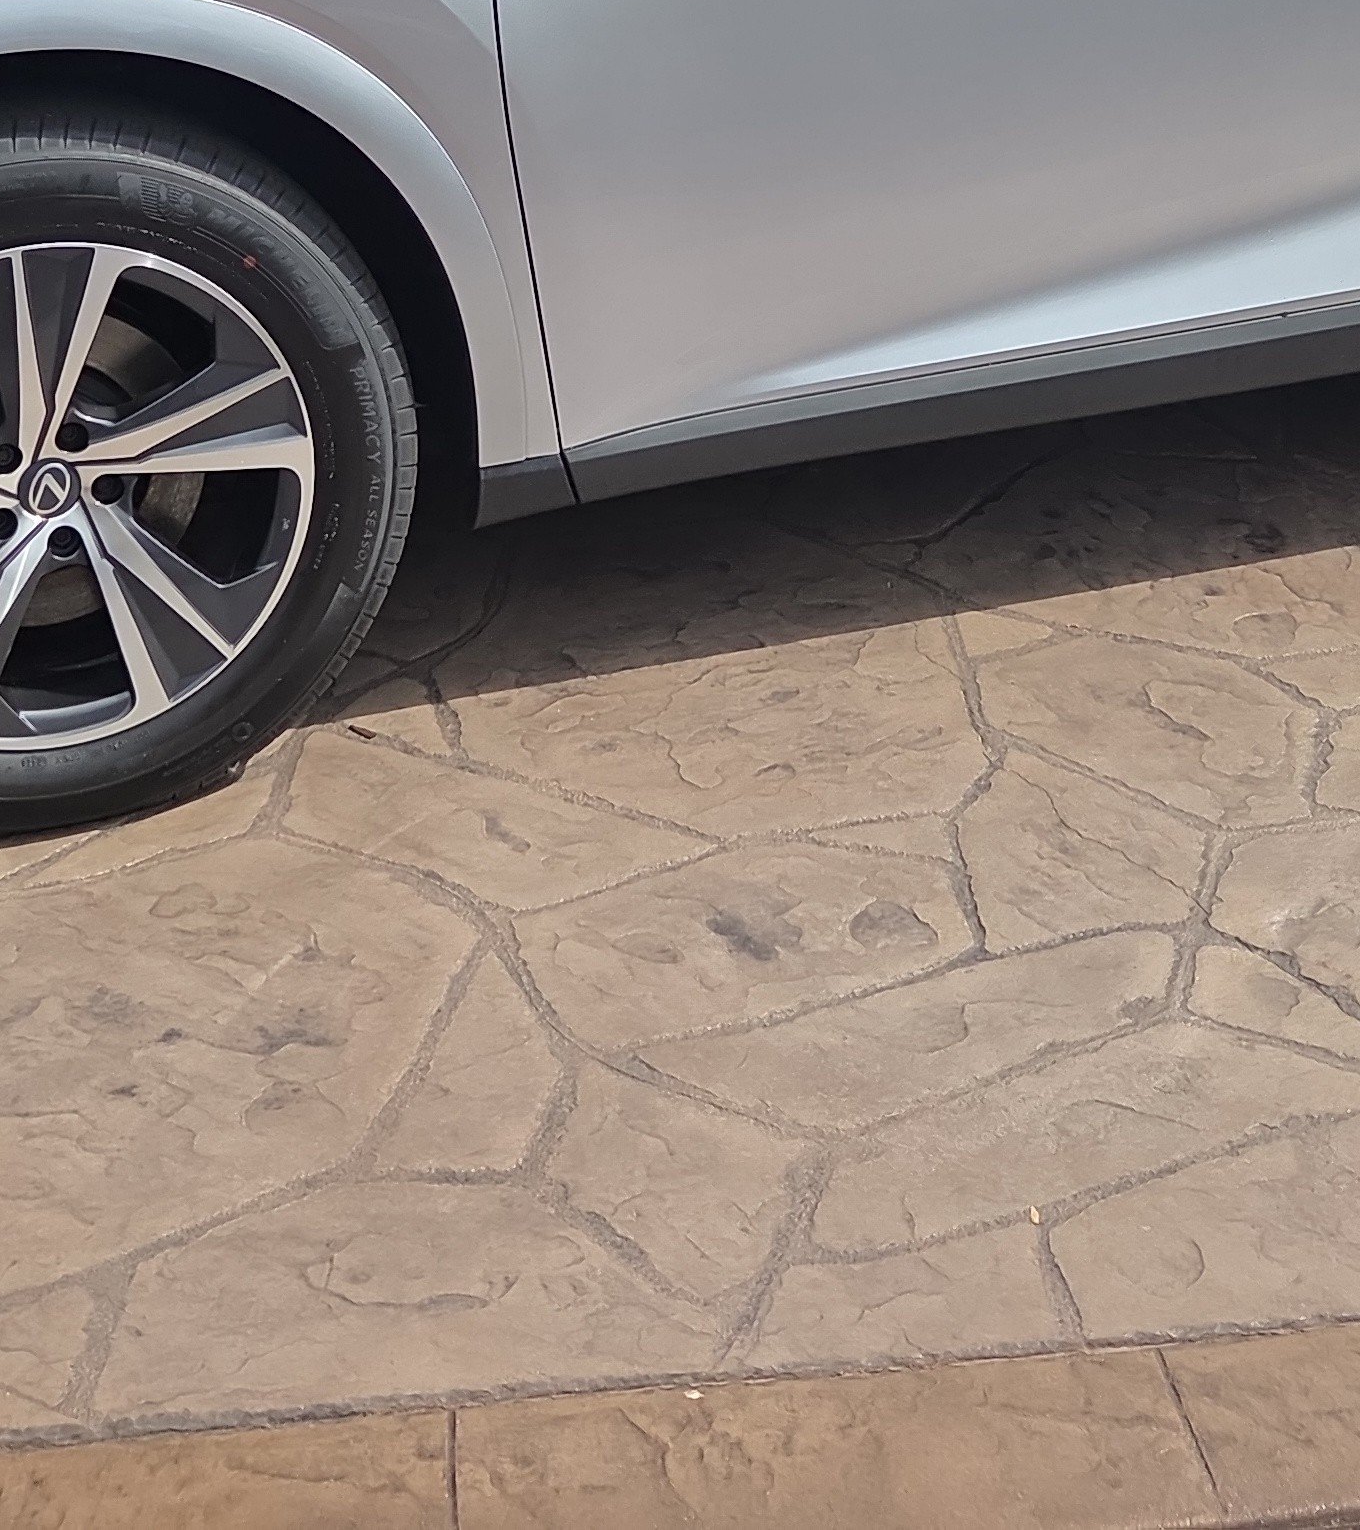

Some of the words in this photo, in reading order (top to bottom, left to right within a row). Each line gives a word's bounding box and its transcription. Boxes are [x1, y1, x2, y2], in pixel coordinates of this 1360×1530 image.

[349, 365, 382, 465] PRIMACY
[367, 472, 382, 502] ALL
[353, 508, 378, 571] SEASON
